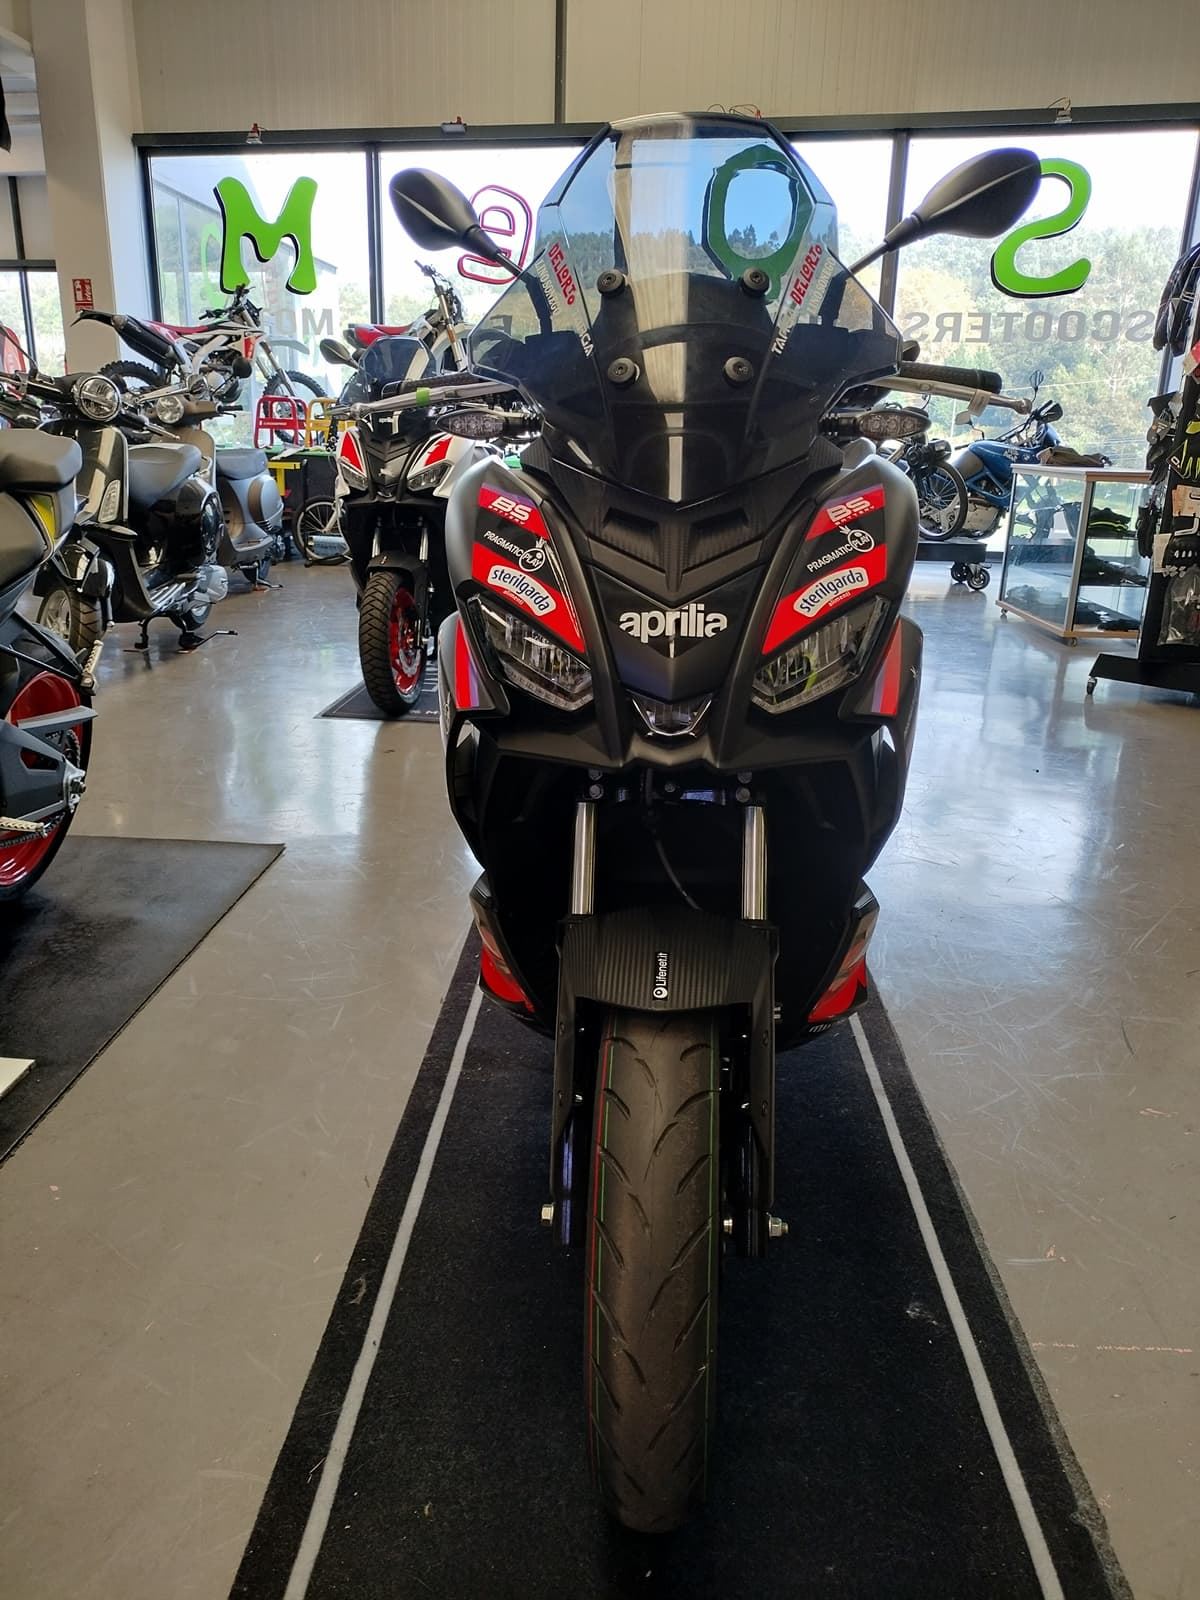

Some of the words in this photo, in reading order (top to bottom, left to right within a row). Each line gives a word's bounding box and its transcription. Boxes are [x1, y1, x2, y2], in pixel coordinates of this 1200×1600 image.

[491, 496, 532, 521] BS
[827, 496, 871, 522] BS
[483, 530, 524, 556] PRAGMATIC
[522, 553, 543, 568] PLAY
[806, 543, 854, 573] PRAGMATIC
[852, 535, 872, 549] PLAY
[491, 568, 550, 611] sterilgarda
[800, 569, 864, 613] sterilgarda
[619, 603, 728, 644] aprilia
